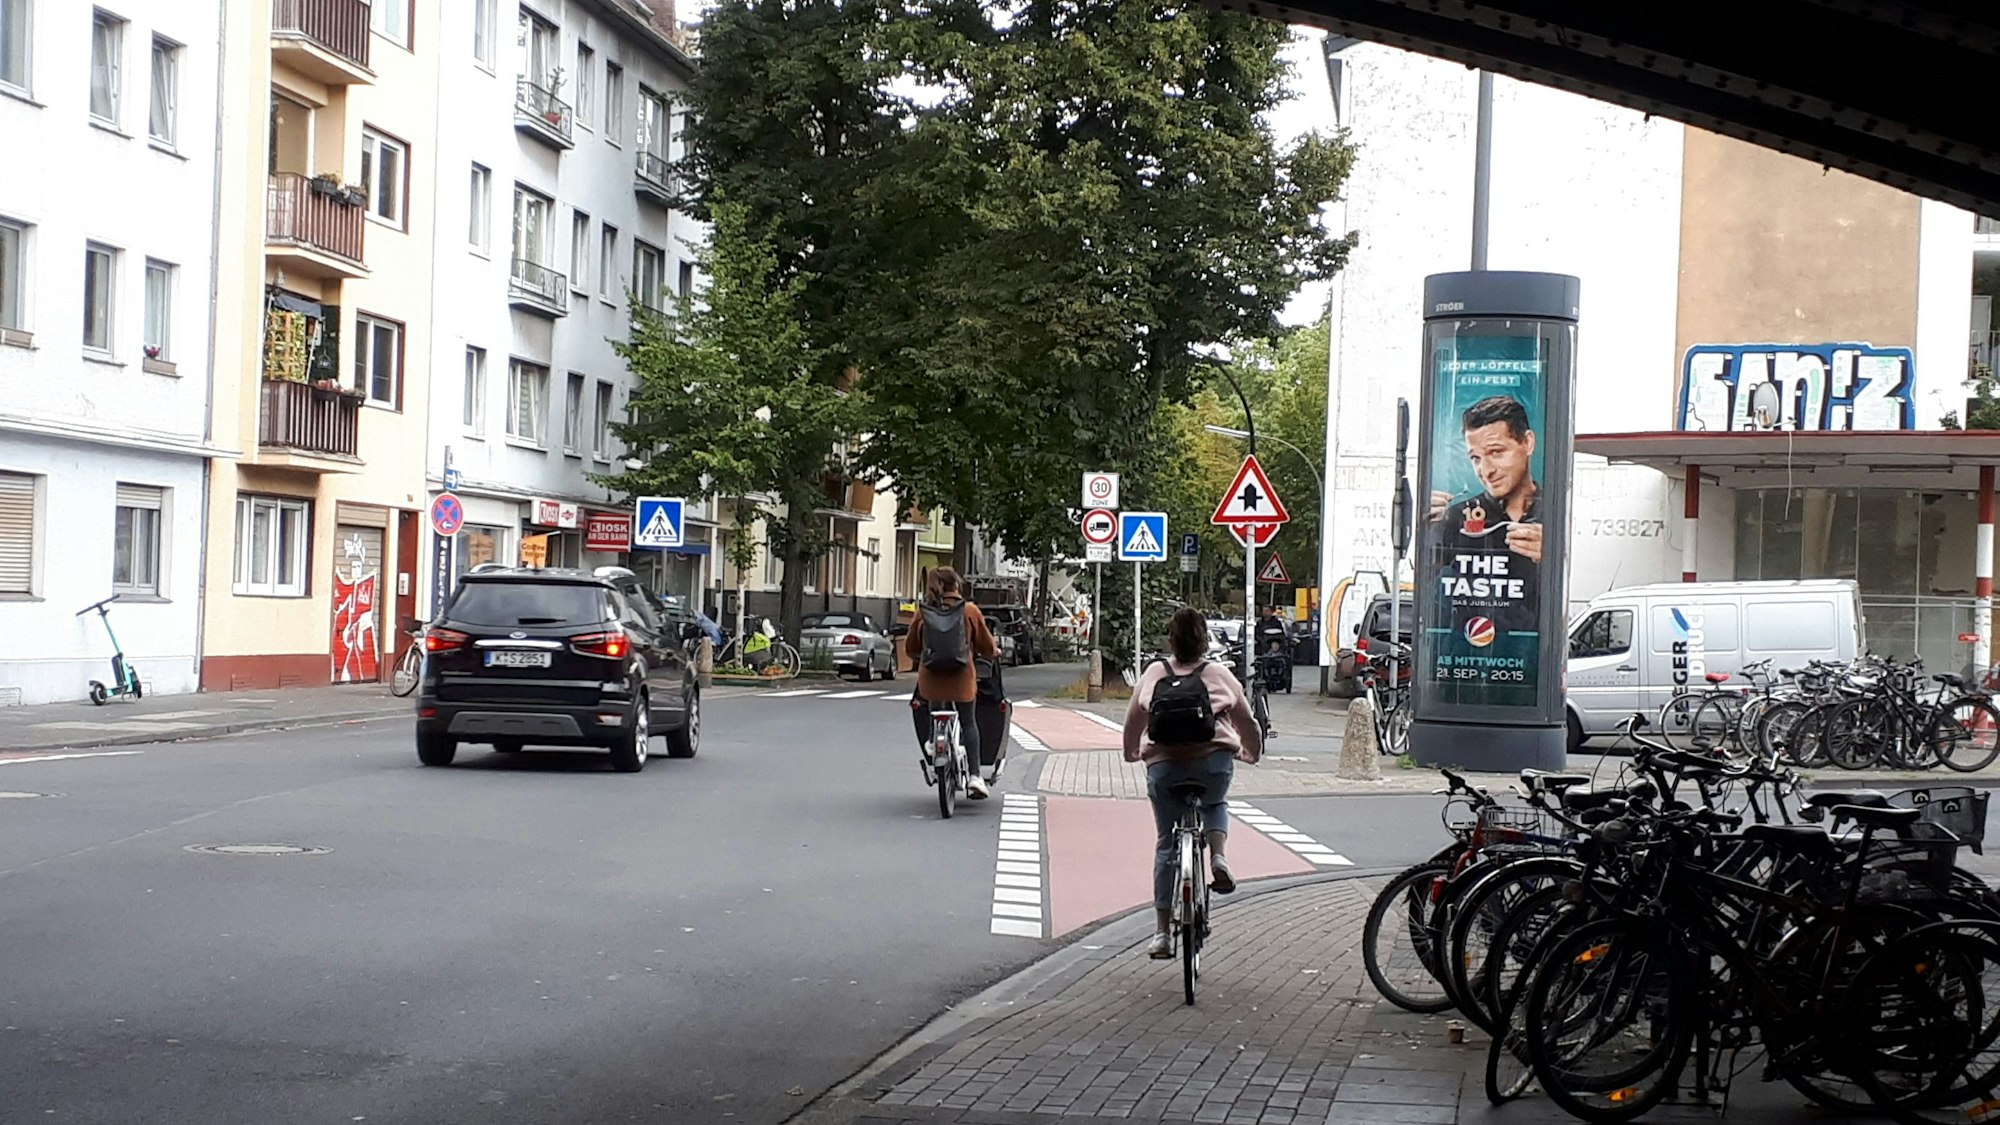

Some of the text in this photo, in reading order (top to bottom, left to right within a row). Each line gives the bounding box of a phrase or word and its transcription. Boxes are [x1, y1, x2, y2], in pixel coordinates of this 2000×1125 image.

[1435, 302, 1465, 313] STRÖER
[1443, 361, 1476, 371] JEDER
[1481, 360, 1527, 370] LÖFFEL
[1460, 376, 1516, 385] EIN FEST
[1094, 482, 1108, 493] 30
[591, 521, 628, 533] KIOSK
[1591, 519, 1665, 537] 733827
[1183, 535, 1195, 553] P
[1455, 554, 1509, 575] THE
[1441, 577, 1524, 598] TASTE
[1452, 599, 1510, 608] DAS JUBILÄUM
[1437, 655, 1524, 668] AB MITTWOCH
[1453, 668, 1478, 679] SEP
[1490, 669, 1524, 681] 20:15
